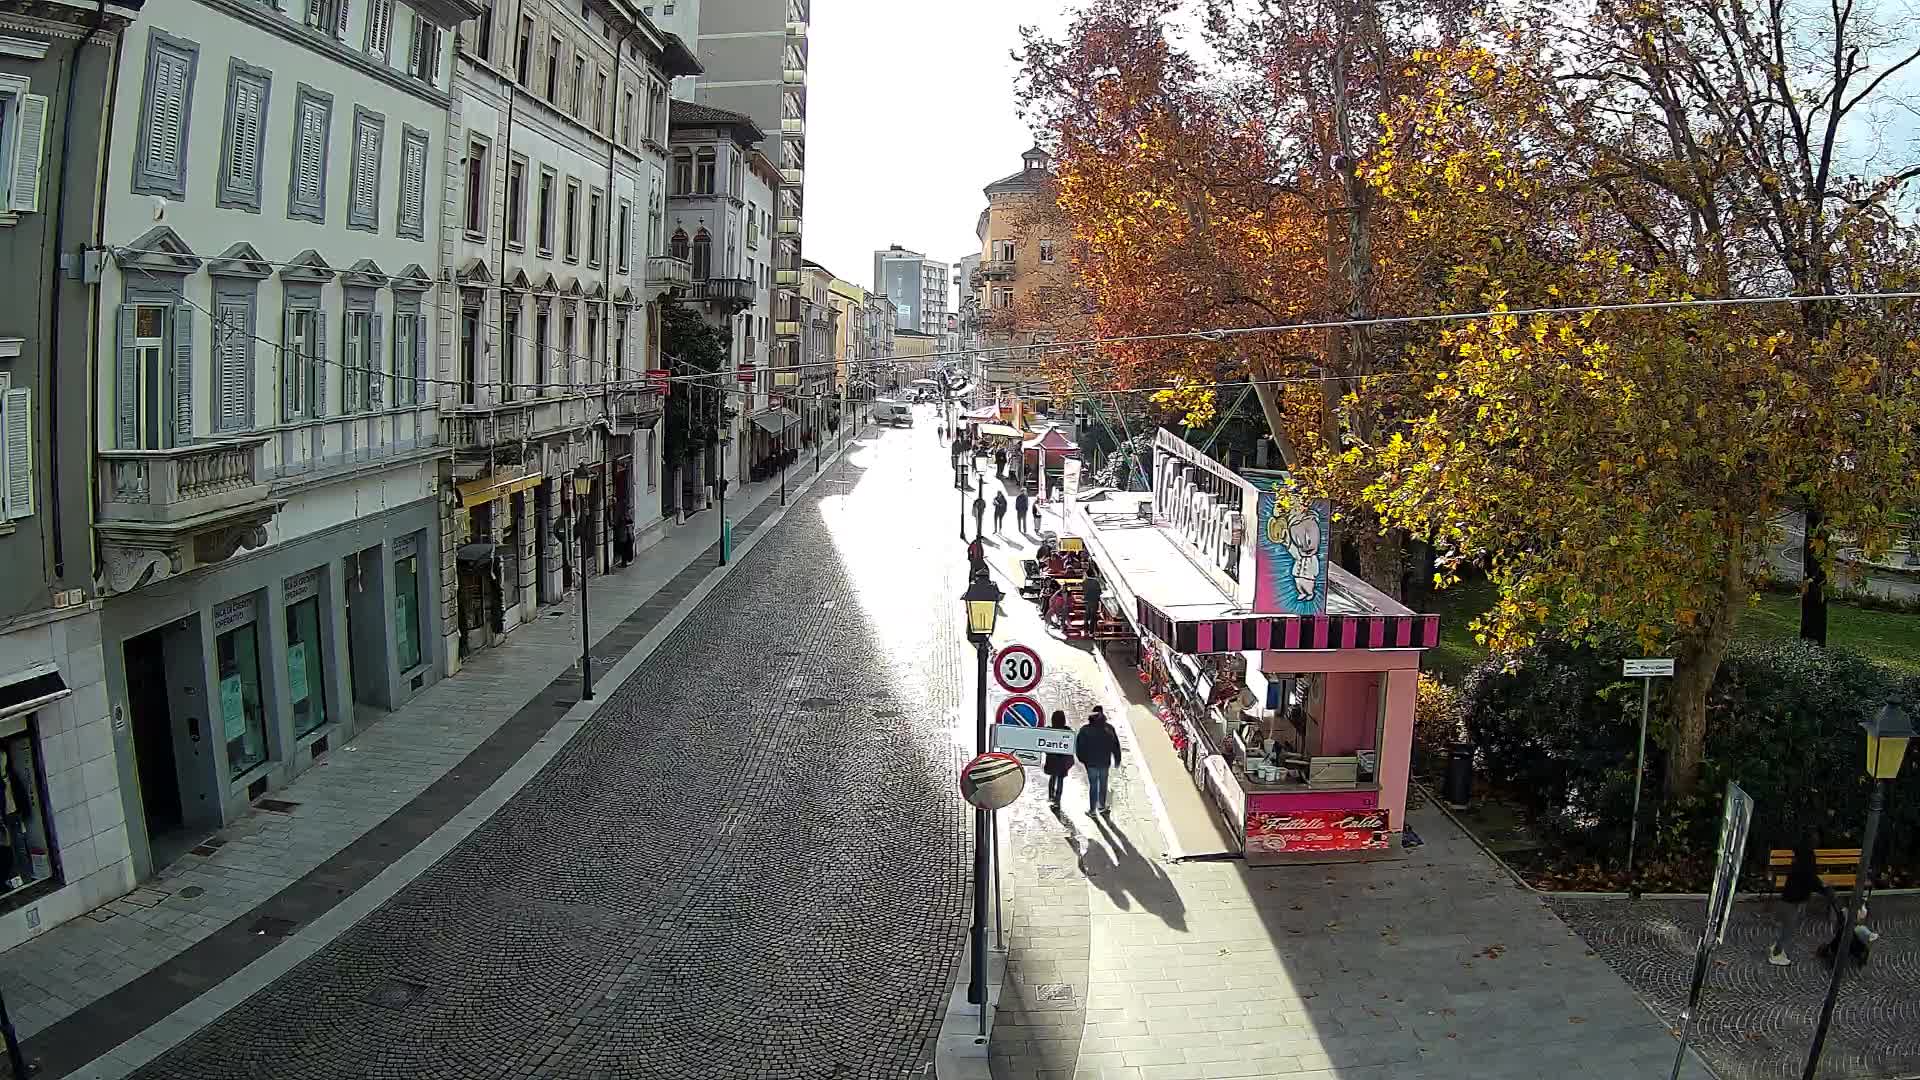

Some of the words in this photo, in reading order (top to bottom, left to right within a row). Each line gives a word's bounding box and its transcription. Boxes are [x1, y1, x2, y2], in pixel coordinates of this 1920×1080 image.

[1005, 658, 1033, 680] 30
[1037, 738, 1069, 749] Dante
[1332, 816, 1383, 828] Calde
